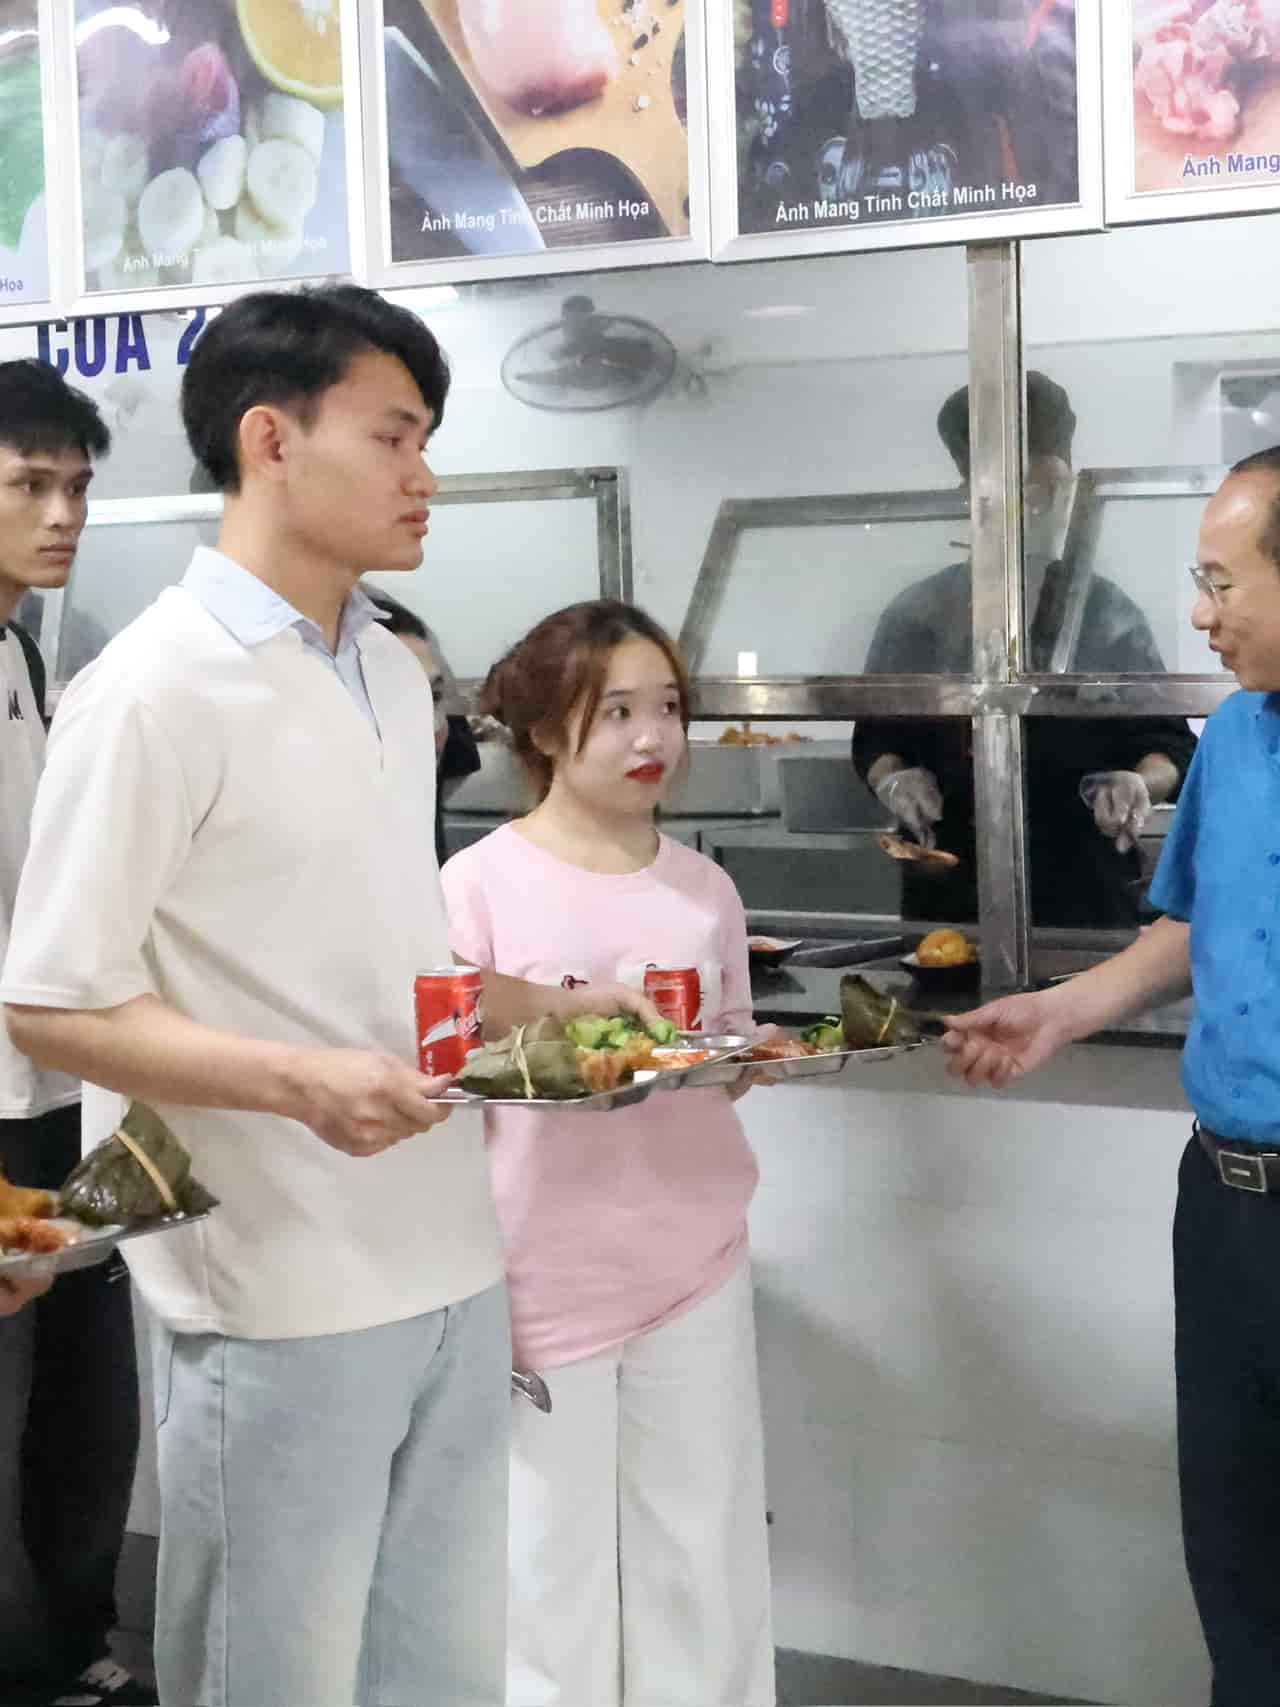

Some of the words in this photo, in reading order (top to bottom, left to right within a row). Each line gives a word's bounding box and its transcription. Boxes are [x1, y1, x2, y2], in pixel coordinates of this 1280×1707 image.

[1227, 152, 1280, 173] Mang
[454, 212, 496, 233] Mang
[536, 200, 571, 224] Chất
[576, 200, 613, 222] Minh
[618, 200, 650, 221] Họa
[814, 200, 860, 219] Mang
[907, 185, 949, 209] Chất
[953, 184, 996, 205] Minh
[1001, 181, 1038, 203] Họa
